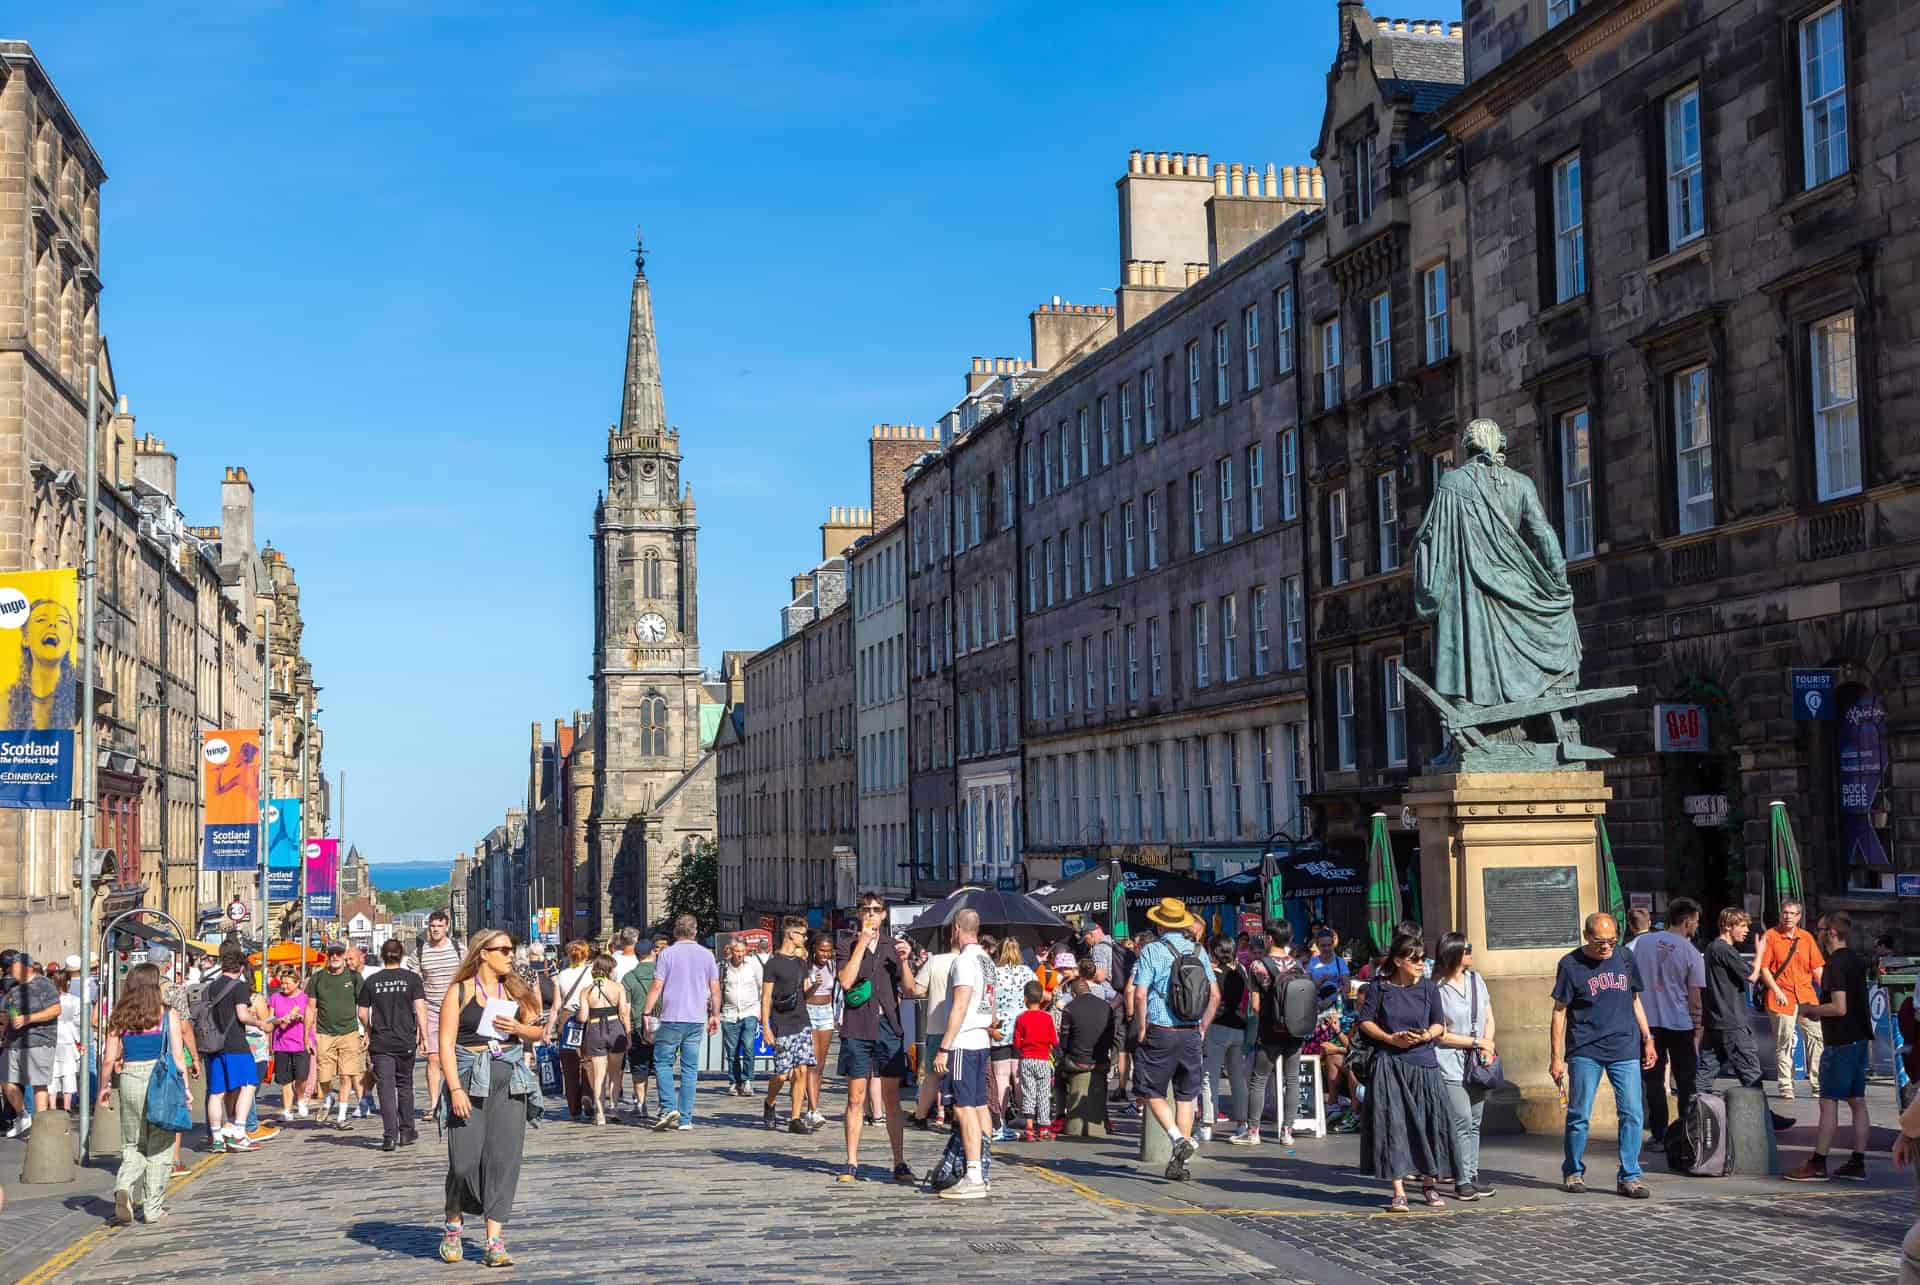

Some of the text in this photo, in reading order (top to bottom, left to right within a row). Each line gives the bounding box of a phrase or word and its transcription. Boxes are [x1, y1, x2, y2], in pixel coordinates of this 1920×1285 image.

[1795, 674, 1831, 685] TOURIST
[1, 741, 60, 756] Scotland
[1843, 795, 1868, 807] HERE
[212, 829, 250, 840] Scotland
[1051, 903, 1082, 914] PIZZA
